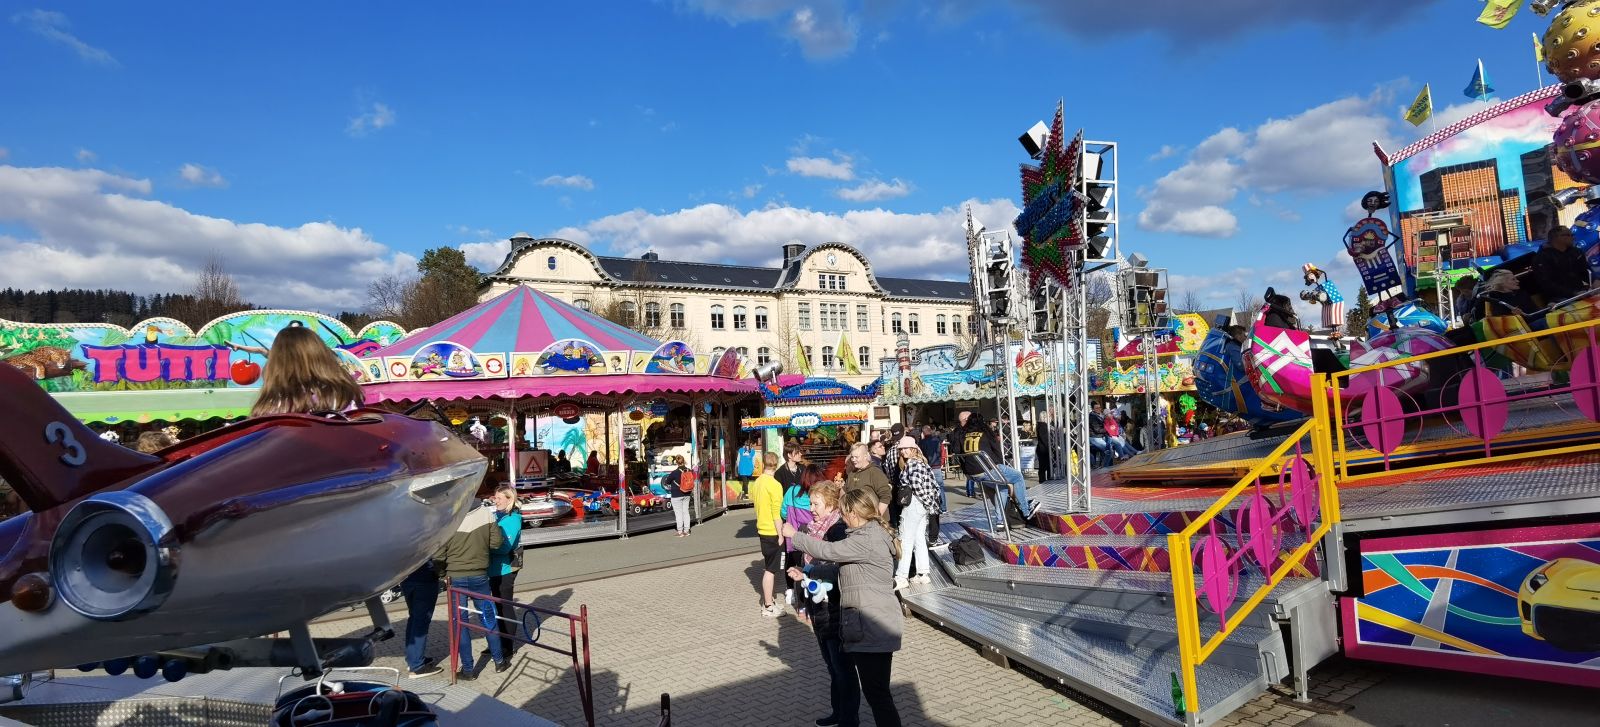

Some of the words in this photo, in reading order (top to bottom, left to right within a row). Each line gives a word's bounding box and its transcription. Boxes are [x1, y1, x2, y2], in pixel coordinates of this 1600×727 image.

[81, 344, 231, 383] TUTTI
[45, 421, 87, 466] 3
[963, 436, 980, 454] 01
